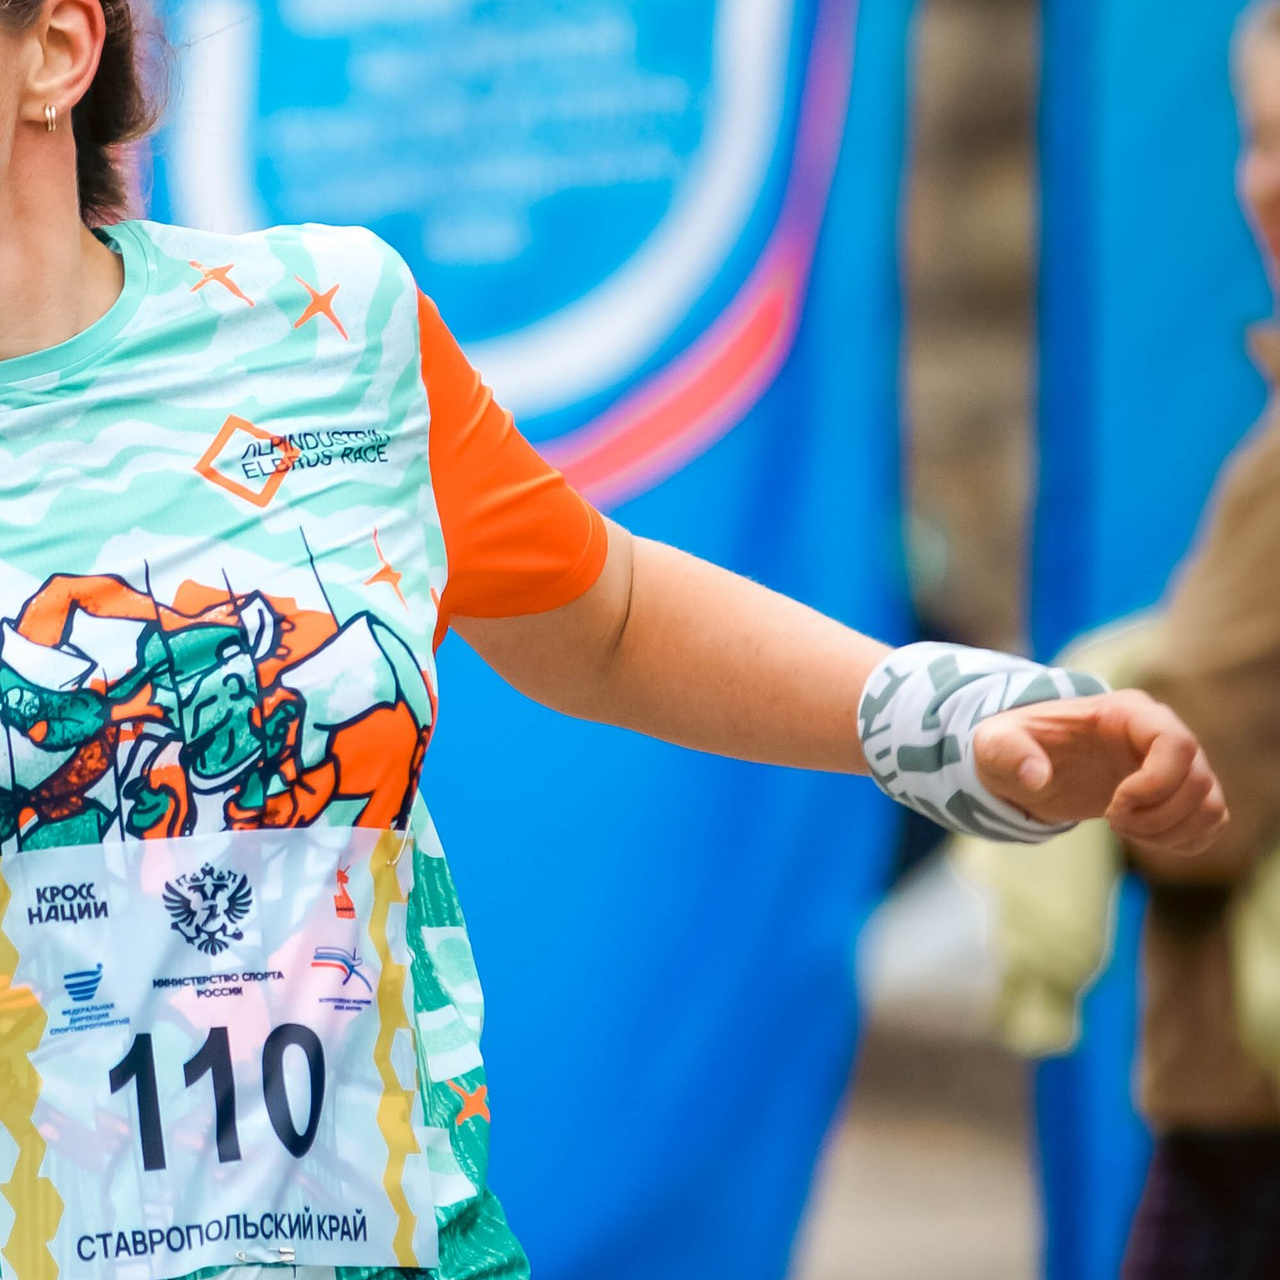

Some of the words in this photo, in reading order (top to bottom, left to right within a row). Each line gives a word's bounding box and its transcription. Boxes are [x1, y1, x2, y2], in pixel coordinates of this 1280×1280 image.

[242, 449, 332, 480] ELBRUS
[340, 442, 389, 464] RACE
[35, 882, 97, 905] КРОСС
[27, 900, 110, 925] НАЦИИ
[152, 973, 240, 989] МИНИСТЕРСТВО
[241, 970, 285, 982] СПОРТА
[196, 986, 243, 999] РОССИИ
[108, 1022, 326, 1172] 110
[76, 1205, 314, 1262] СТАВРОПОЛЬСКИЙ
[317, 1208, 368, 1242] КРАЙ
